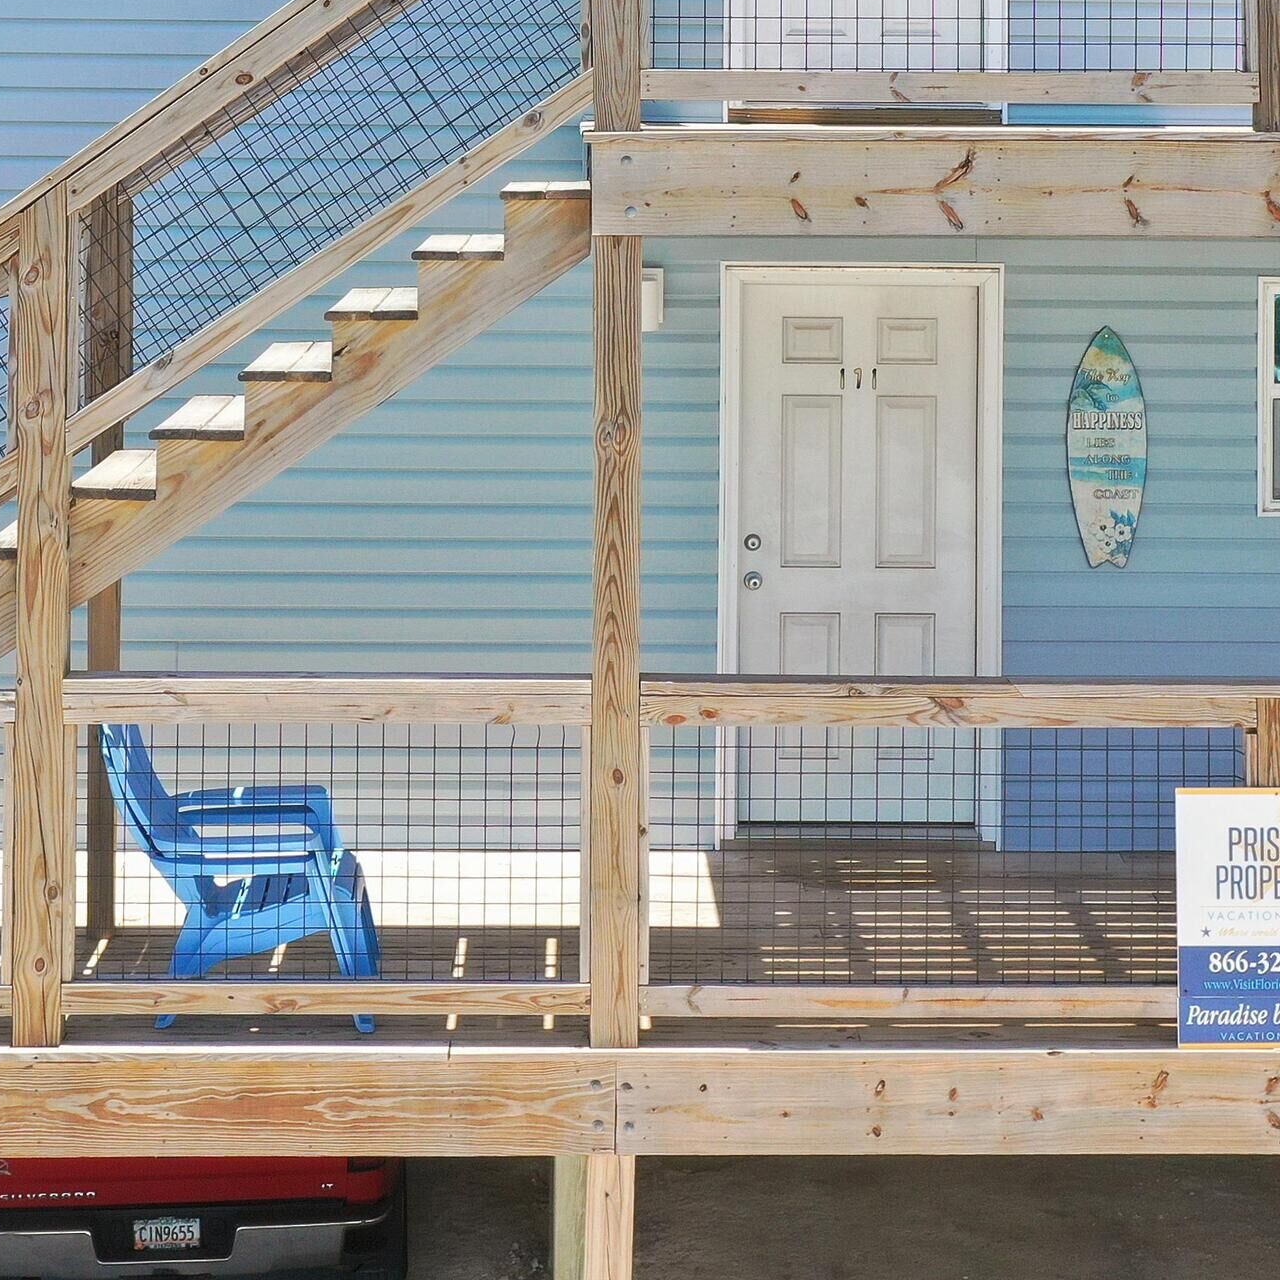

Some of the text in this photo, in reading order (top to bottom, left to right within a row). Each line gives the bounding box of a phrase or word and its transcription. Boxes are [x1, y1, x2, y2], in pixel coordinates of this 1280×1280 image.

[840, 367, 878, 390] 171
[1072, 411, 1143, 430] HAPPINESS
[1085, 454, 1131, 465] ALONG
[1106, 469, 1132, 481] THE
[1093, 488, 1139, 500] COAST
[1186, 1003, 1269, 1026] Paradise
[139, 1224, 195, 1242] CIN9655
